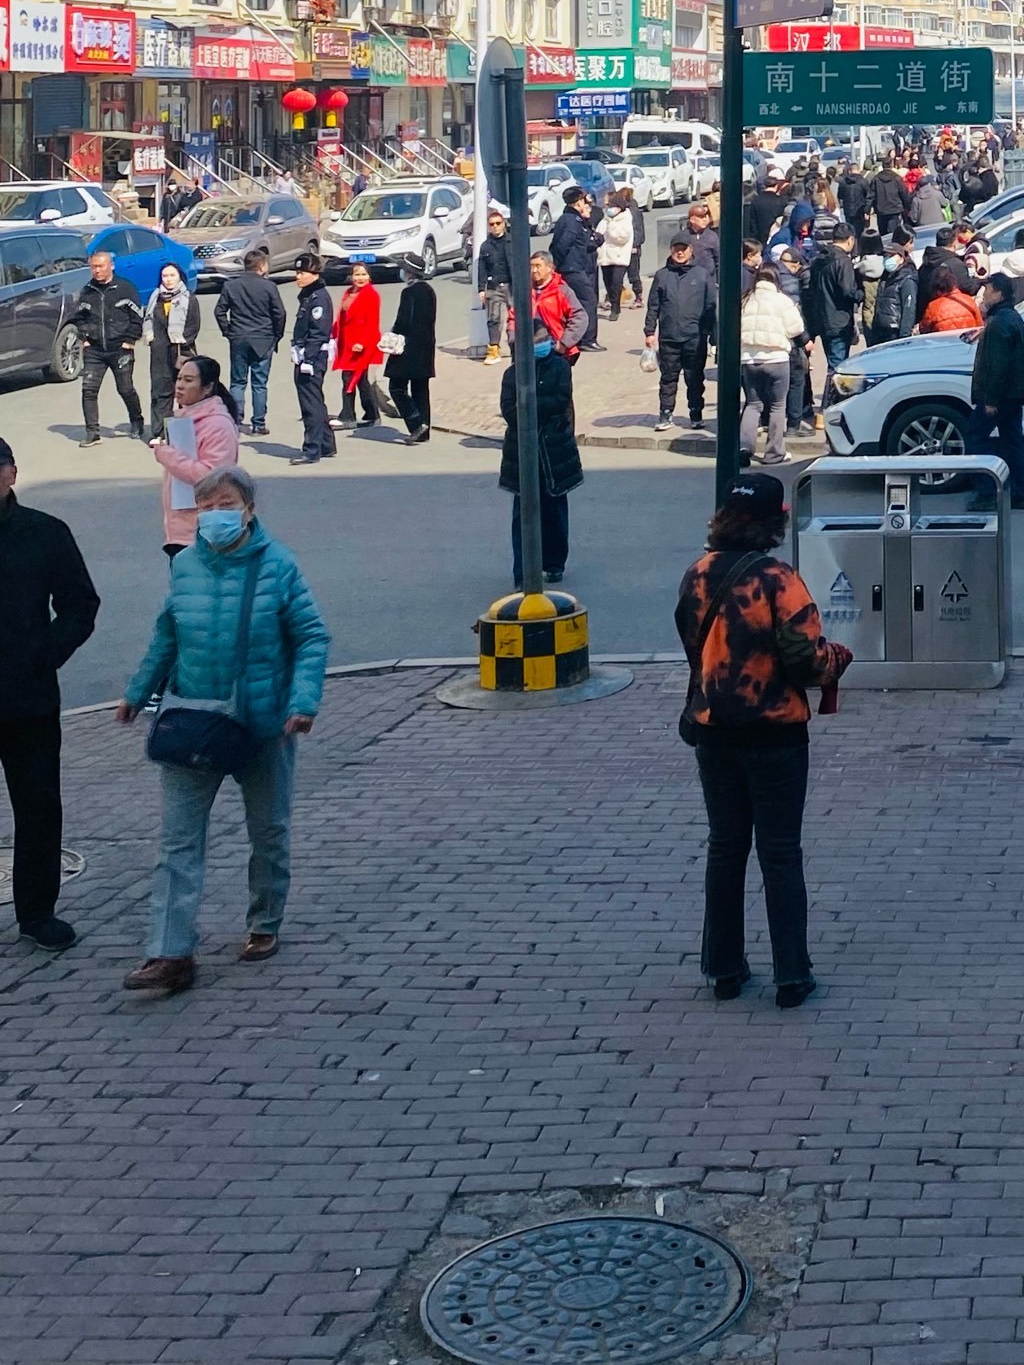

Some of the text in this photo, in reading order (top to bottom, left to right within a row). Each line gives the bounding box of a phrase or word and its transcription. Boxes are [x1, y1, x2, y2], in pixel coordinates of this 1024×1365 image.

[765, 60, 971, 93] 南十二道街
[557, 95, 627, 108] 广达医疗器械
[957, 101, 979, 114] 东南
[758, 103, 780, 115] 西北
[816, 102, 918, 115] NANSHIERDAO JIE
